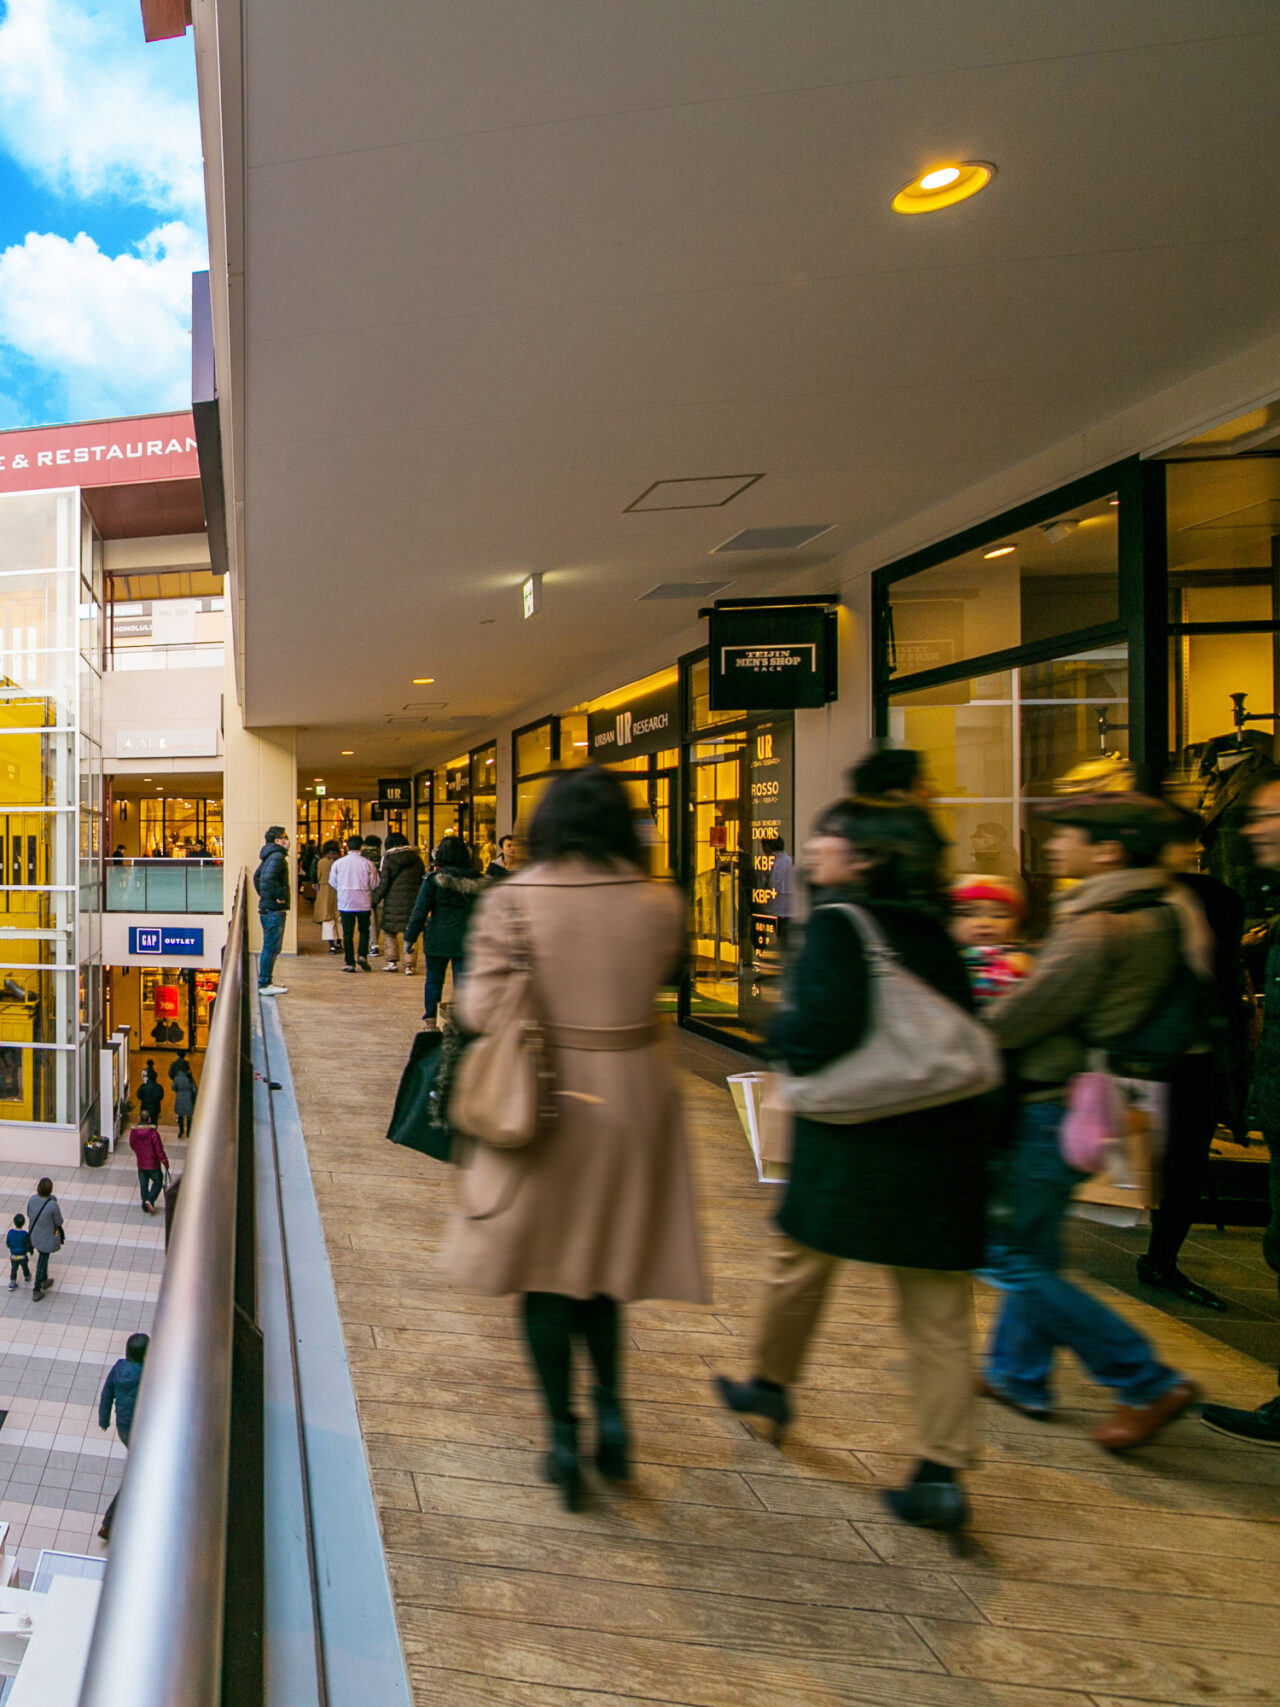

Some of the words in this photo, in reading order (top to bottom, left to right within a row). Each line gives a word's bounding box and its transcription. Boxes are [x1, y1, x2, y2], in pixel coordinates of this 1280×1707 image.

[12, 454, 30, 469] &
[37, 437, 198, 467] RESTAURAN
[745, 650, 791, 658] TEIJIN
[769, 656, 802, 666] SHOP
[594, 730, 615, 748] URBAN
[616, 711, 632, 747] UR
[632, 713, 669, 737] RESEARCH
[757, 734, 773, 760] UR
[387, 788, 402, 800] UR
[751, 781, 780, 797] ROSSO
[751, 827, 779, 840] DOORS
[754, 855, 776, 871] KBF
[141, 934, 157, 946] GAP
